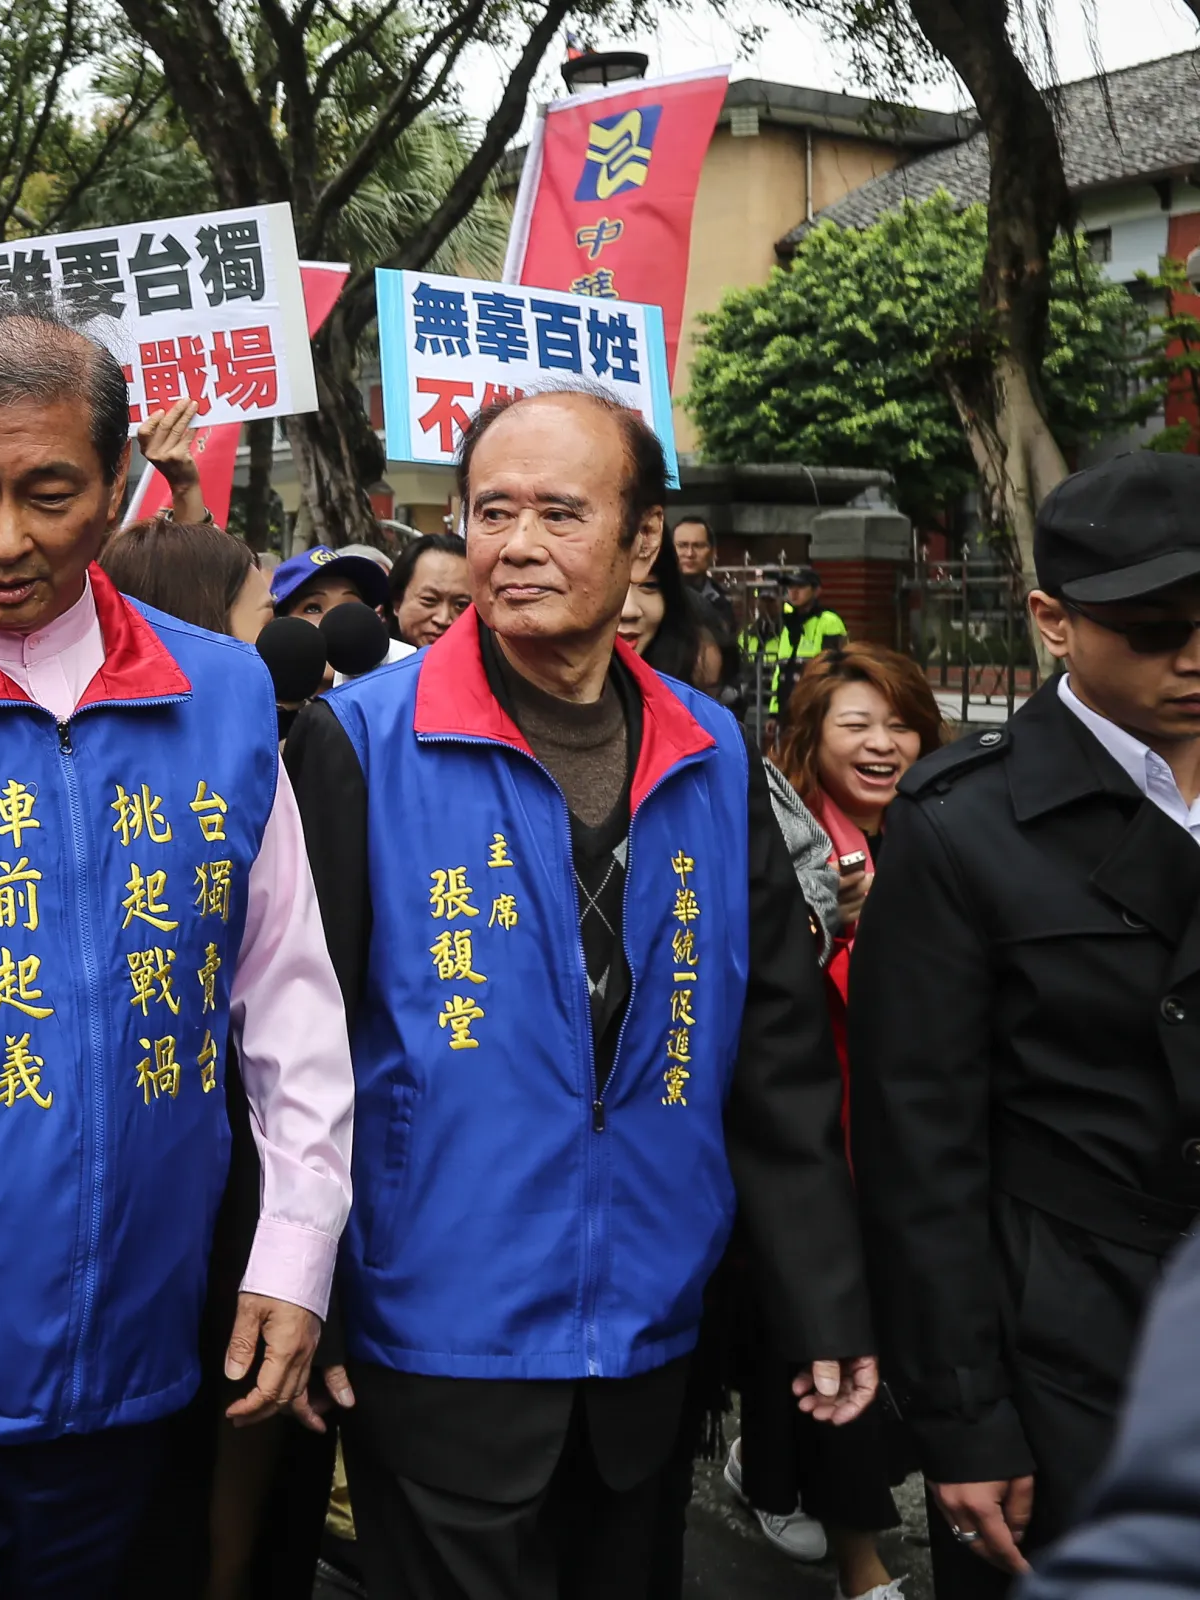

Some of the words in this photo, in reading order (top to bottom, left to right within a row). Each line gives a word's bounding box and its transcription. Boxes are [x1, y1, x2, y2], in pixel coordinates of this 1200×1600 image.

[122, 325, 279, 423] 戰場
[411, 281, 641, 384] 無辜百姓
[111, 782, 181, 1106] 挑起戰禍
[190, 780, 233, 1095] 台獨賣台
[429, 865, 488, 1051] 張馥堂
[486, 832, 519, 931] 主席
[661, 849, 701, 1107] 中華統一促進黨
